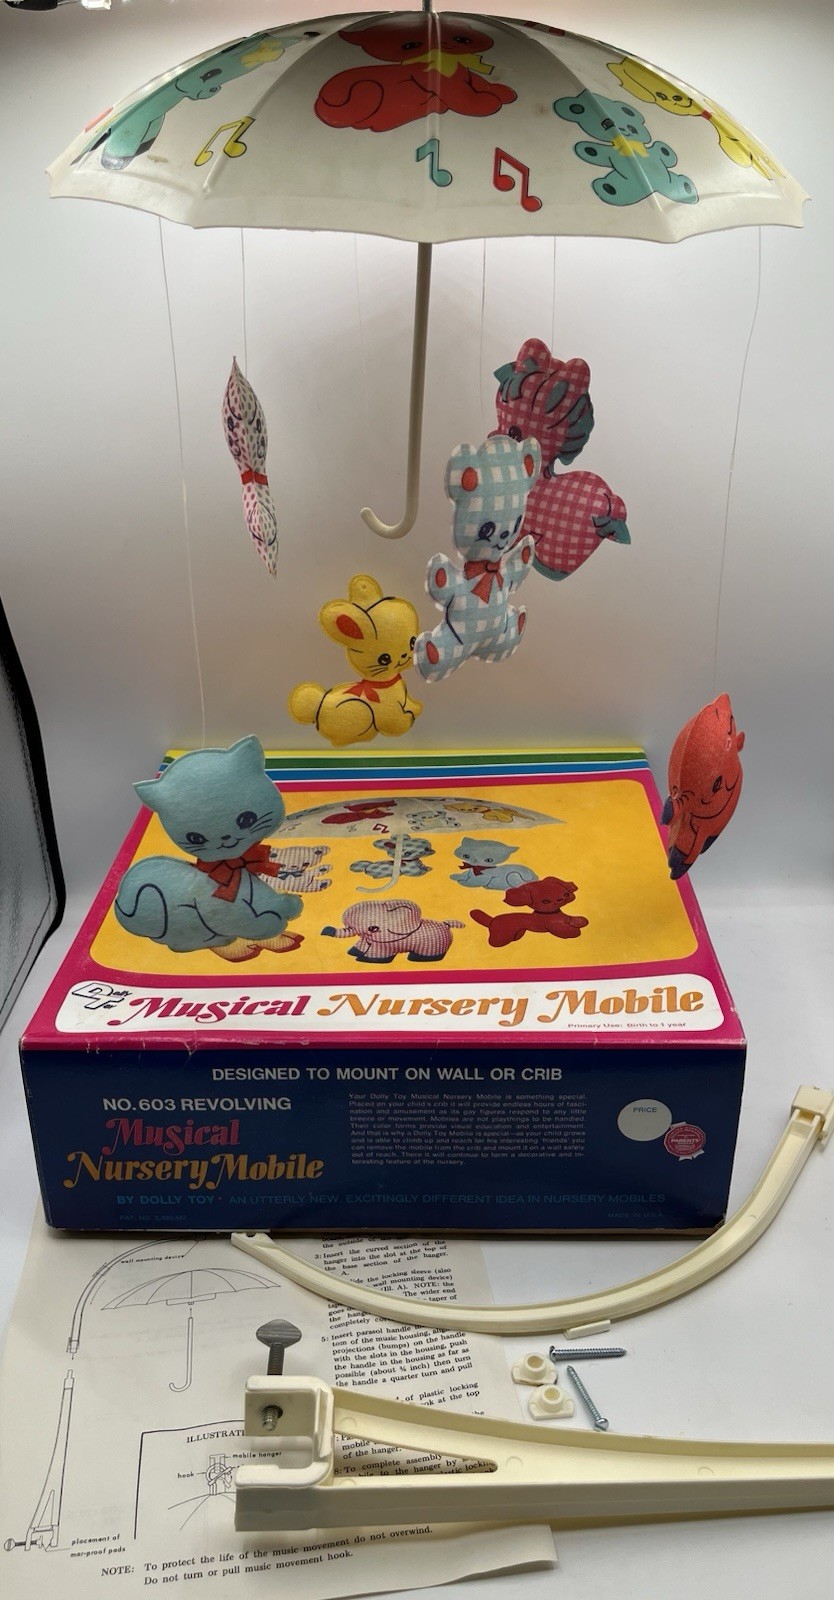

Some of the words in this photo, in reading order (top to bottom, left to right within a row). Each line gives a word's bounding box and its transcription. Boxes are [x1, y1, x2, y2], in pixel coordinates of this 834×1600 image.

[107, 995, 311, 1026] Musical
[316, 993, 528, 1027] Nursery
[537, 985, 704, 1023] Mobile
[212, 1067, 300, 1080] DESIGNED
[305, 1067, 330, 1080] TO
[336, 1067, 399, 1080] MOUNT
[405, 1067, 430, 1080] ON
[437, 1067, 484, 1080] WALL
[489, 1067, 515, 1080] OR
[521, 1067, 563, 1080] CRIB
[181, 1097, 292, 1111] REVOLVING
[102, 1117, 240, 1157] Musical
[63, 1151, 208, 1190] Nursery
[205, 1153, 324, 1191] Mobile
[117, 1195, 134, 1204] BY
[140, 1195, 182, 1204] DOLLY
[187, 1195, 215, 1204] TOY
[229, 1195, 246, 1204] AN
[250, 1195, 305, 1204] UTTERLY
[346, 1194, 419, 1203] EXCITINGLY
[422, 1194, 492, 1203] DIFFERENT
[496, 1194, 525, 1204] IDEA
[528, 1194, 540, 1203] IN
[544, 1194, 605, 1203] NURSERY
[608, 1194, 666, 1203] MOBILES
[323, 1251, 344, 1259] Insert
[394, 1242, 418, 1250] section
[323, 1258, 347, 1266] hanger
[424, 1246, 436, 1254] top
[423, 1251, 449, 1259] hanger.
[381, 1270, 407, 1280] locking
[331, 1332, 353, 1340] Insert
[356, 1328, 383, 1338] parasol
[386, 1325, 411, 1334] handle
[332, 1345, 375, 1356] projections
[378, 1342, 410, 1350] (bumps)
[441, 1332, 466, 1341] handle
[370, 1351, 388, 1359] slots
[400, 1348, 413, 1356] the
[449, 1339, 468, 1348] push
[334, 1370, 365, 1379] possible
[370, 1367, 396, 1376] (about
[409, 1362, 430, 1371] inch)
[434, 1359, 451, 1367] then
[454, 1355, 471, 1363] turn
[350, 1361, 376, 1369] handle
[405, 1354, 435, 1363] housing
[352, 1376, 378, 1386] handle
[390, 1374, 418, 1383] quarter
[421, 1370, 438, 1378] turn
[458, 1362, 473, 1372] pull
[186, 1430, 245, 1444] ILLUSTRATI
[258, 1451, 282, 1459] hanger
[71, 1536, 109, 1546] placement
[70, 1548, 106, 1558] mar-proof
[108, 1546, 126, 1554] pads
[101, 1566, 135, 1576] NOTE:
[144, 1562, 157, 1571] To
[162, 1558, 195, 1571] protect
[200, 1555, 215, 1564] the
[219, 1553, 235, 1562] life
[239, 1550, 250, 1559] of
[253, 1549, 268, 1557] the
[272, 1546, 299, 1556] music
[303, 1538, 349, 1552] movement
[354, 1535, 365, 1544] do
[370, 1532, 386, 1540] not
[390, 1526, 433, 1538] overwind.
[144, 1576, 158, 1585] Do
[162, 1573, 179, 1583] not
[184, 1571, 203, 1580] turn
[222, 1566, 240, 1576] pull
[245, 1563, 271, 1573] music
[276, 1555, 323, 1569] movement
[328, 1550, 353, 1560] hook.
